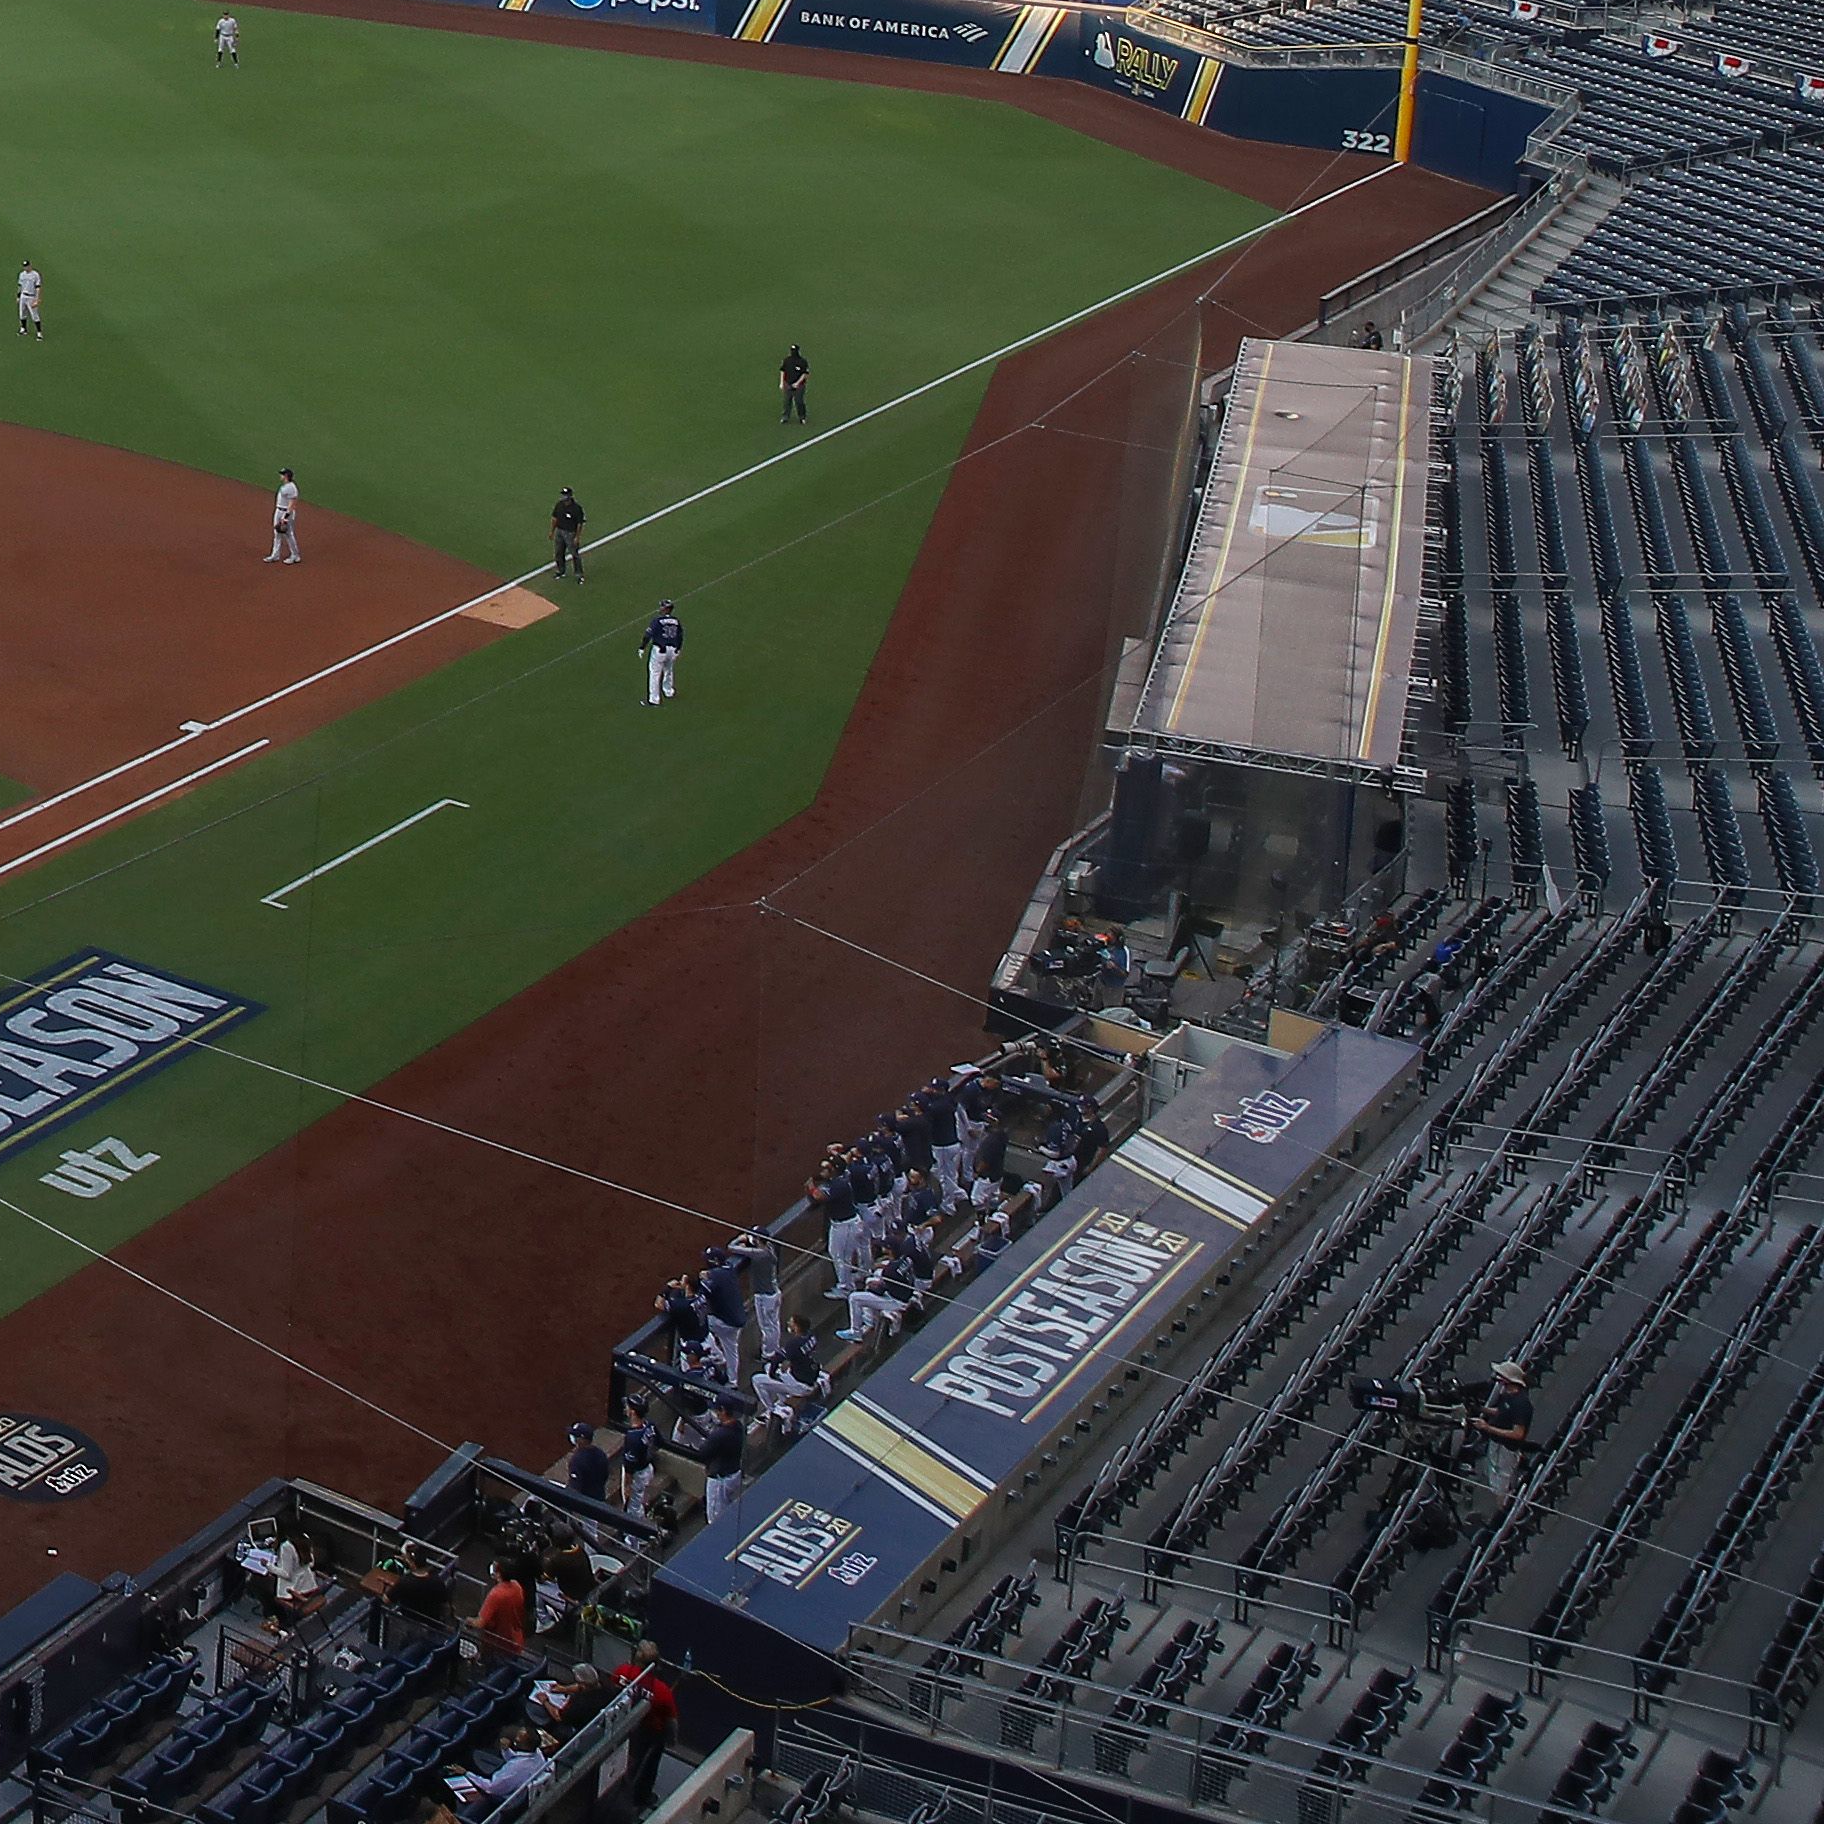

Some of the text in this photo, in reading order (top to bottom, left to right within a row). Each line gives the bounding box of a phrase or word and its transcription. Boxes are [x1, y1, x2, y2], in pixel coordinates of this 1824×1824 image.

[800, 10, 950, 41] BANK OF AMERICA
[1115, 35, 1178, 92] RALLY
[1342, 129, 1391, 154] 322
[39, 1136, 161, 1200] utz
[923, 1225, 1161, 1419] POSTSEASON
[737, 1515, 837, 1586] ALDS
